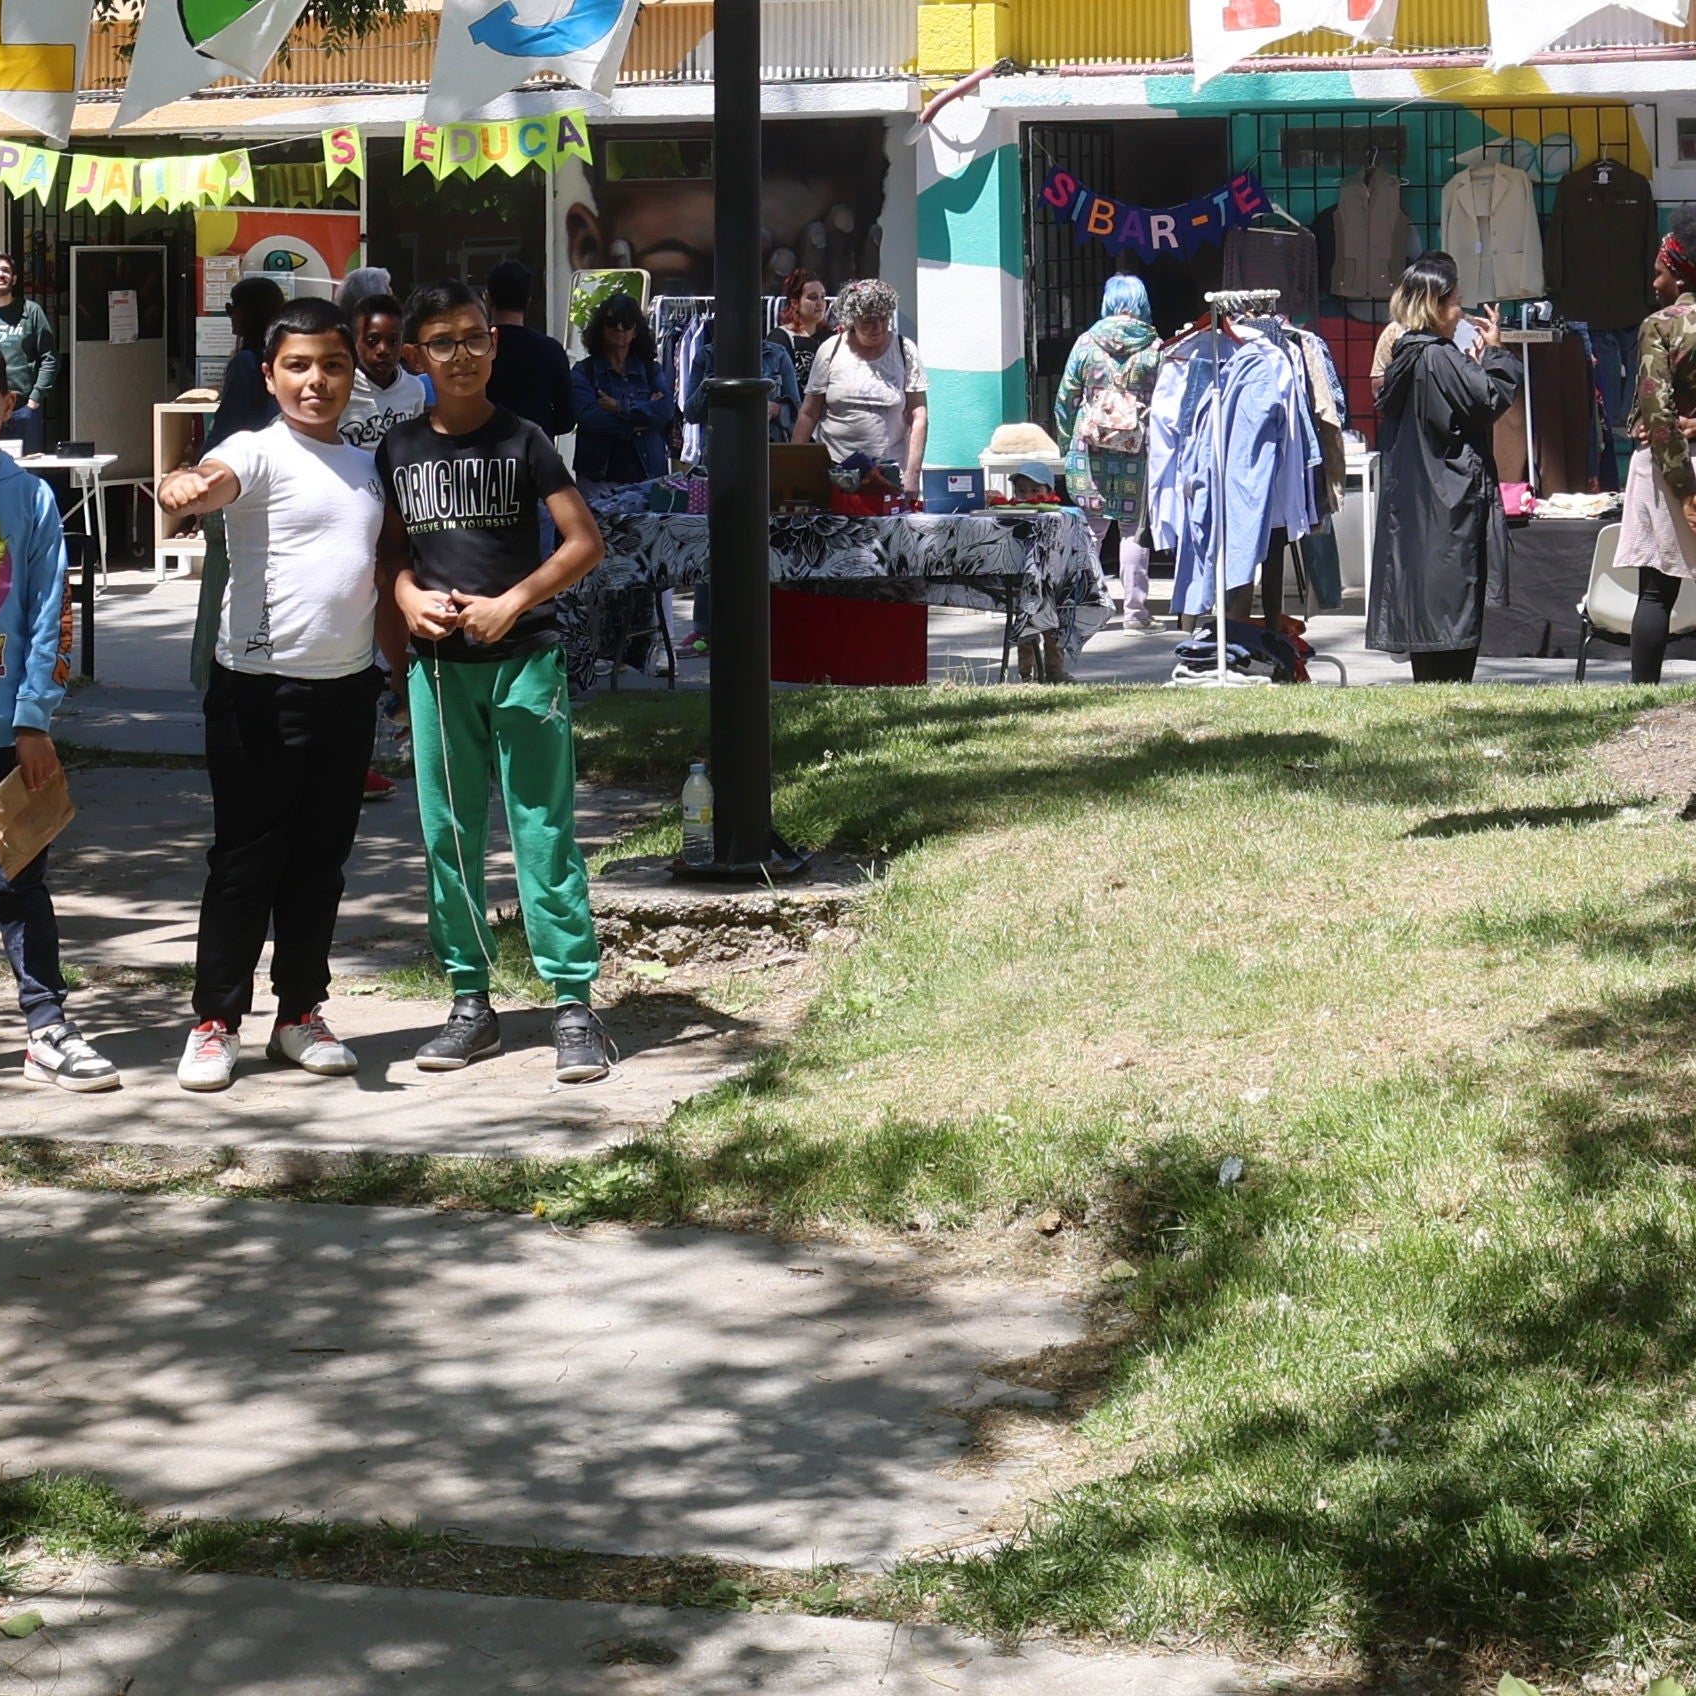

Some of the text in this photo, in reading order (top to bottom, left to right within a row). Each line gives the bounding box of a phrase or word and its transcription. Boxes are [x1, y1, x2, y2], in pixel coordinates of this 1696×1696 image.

[413, 115, 585, 163] EDUCA
[1044, 172, 1262, 250] SIBAR-TE
[393, 458, 520, 524] ORIGINAL
[443, 520, 456, 529] IN
[460, 517, 518, 530] YOURSELF
